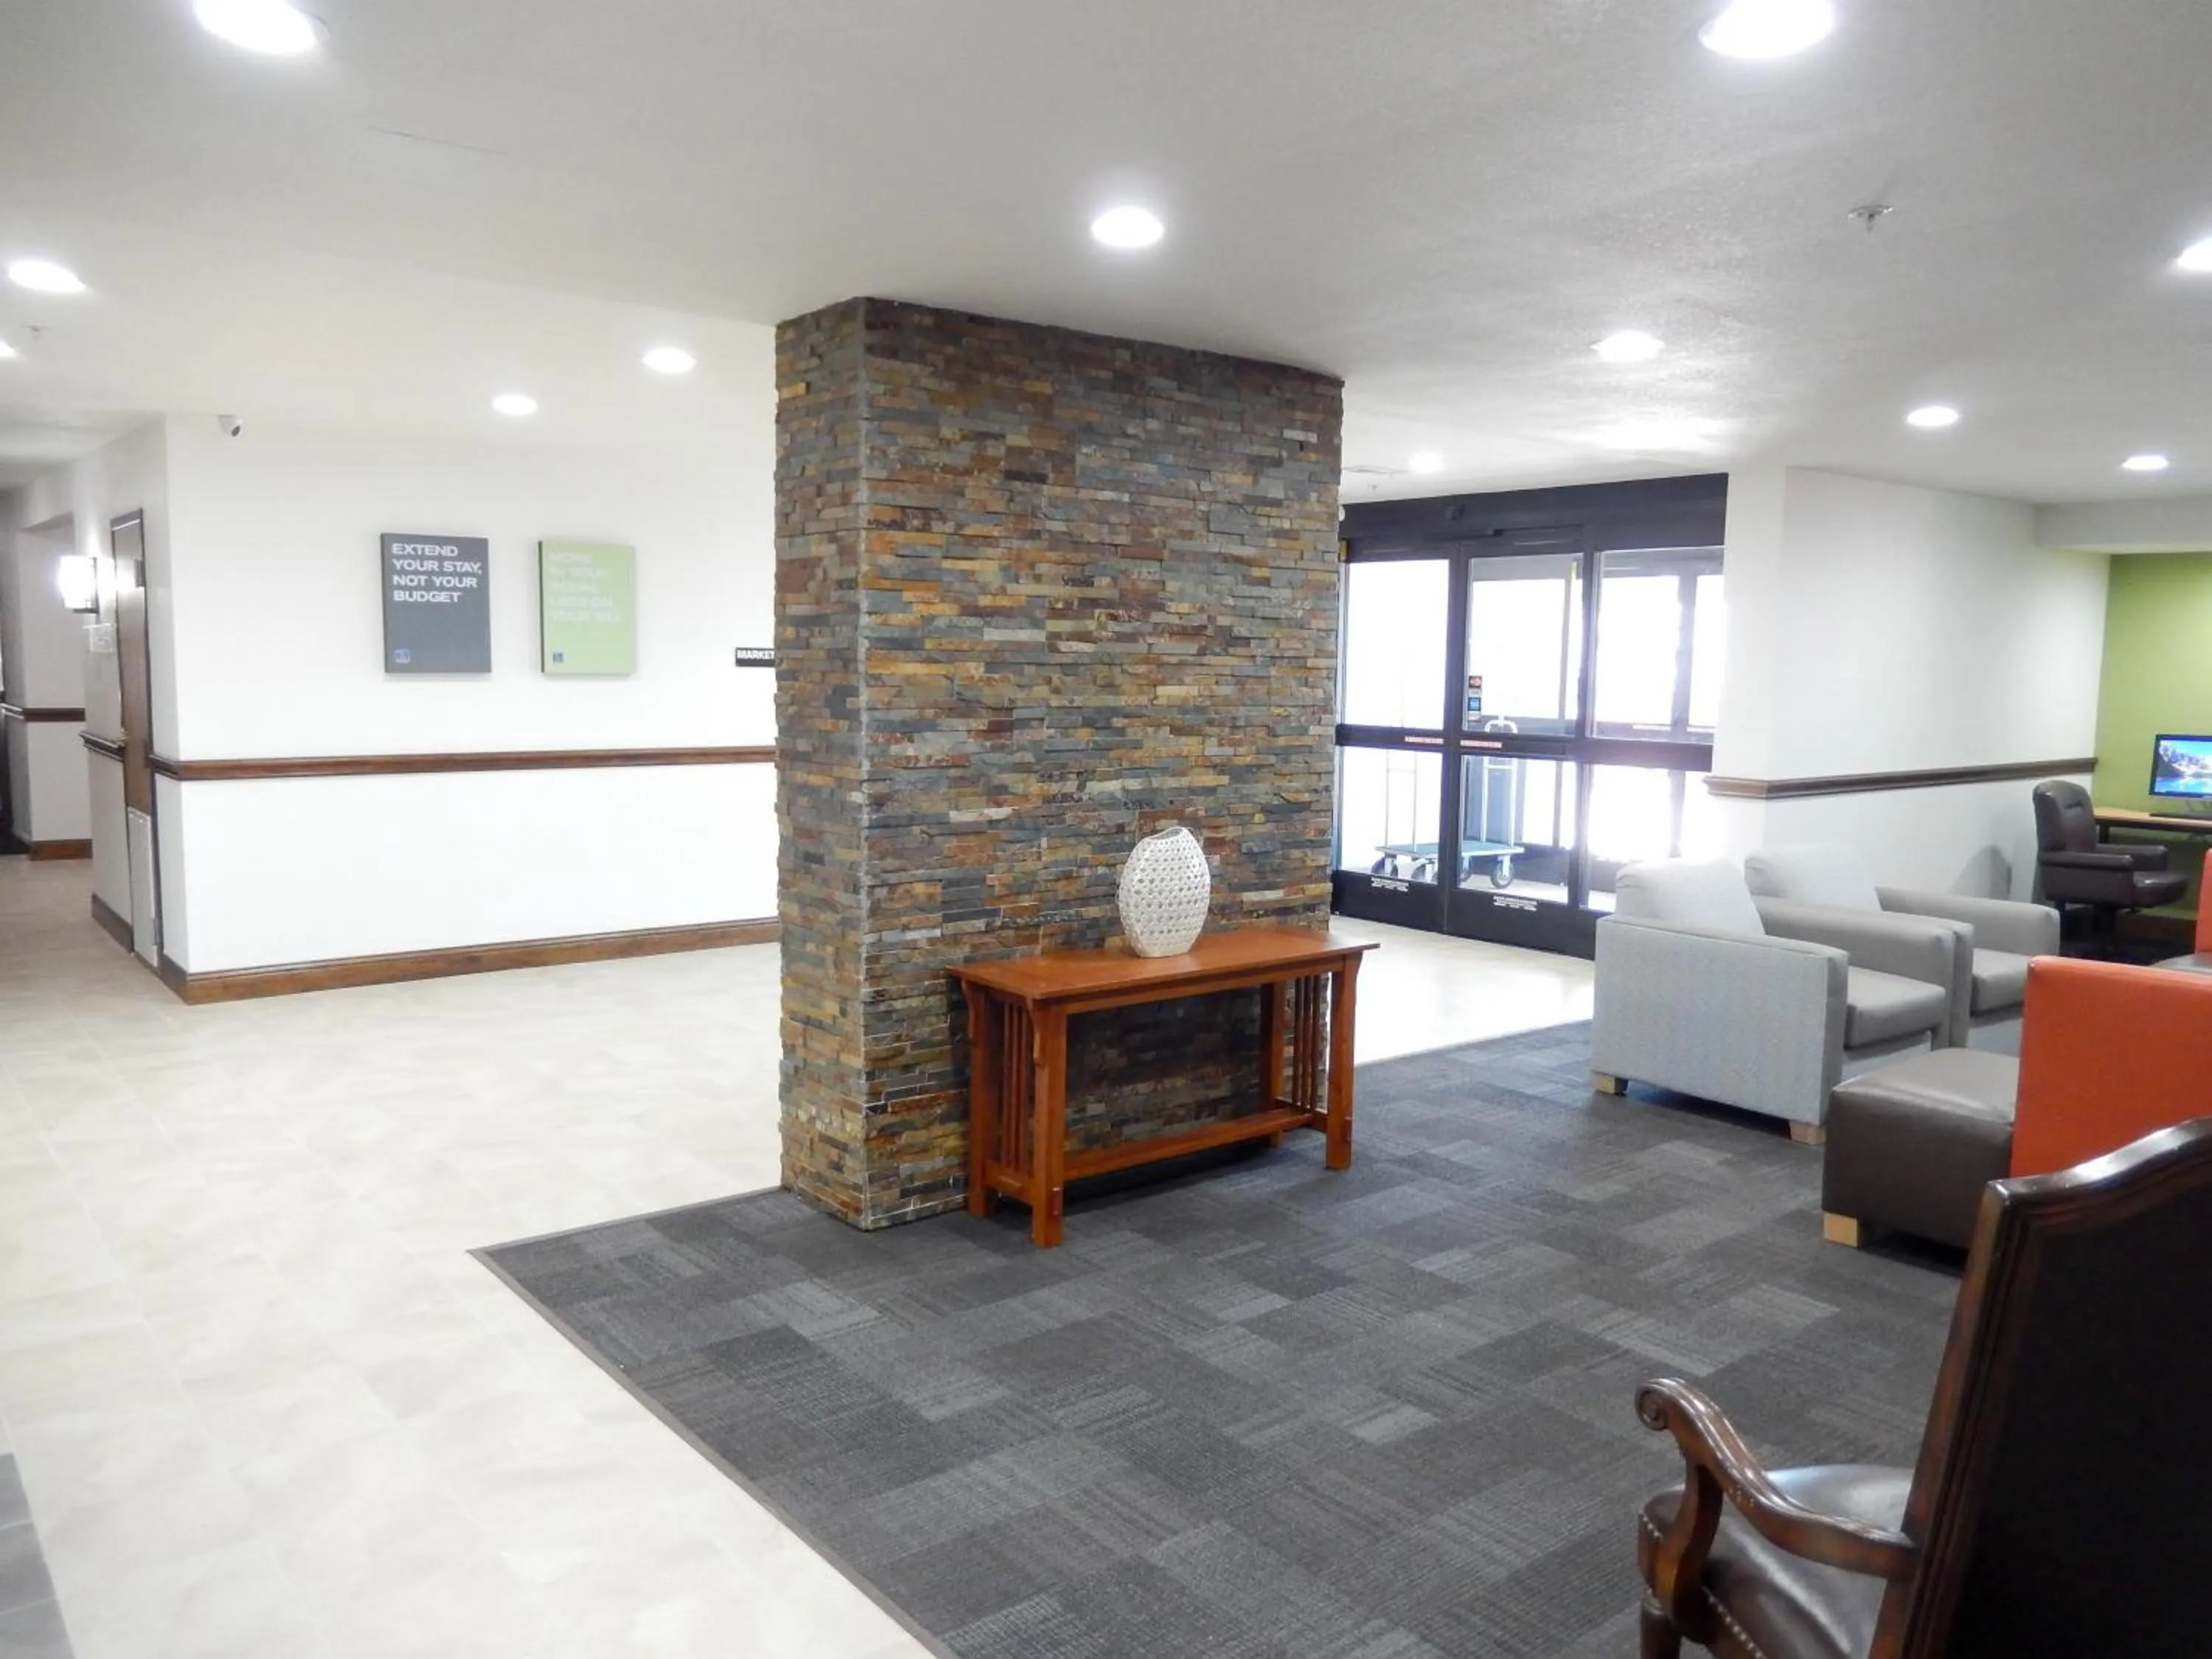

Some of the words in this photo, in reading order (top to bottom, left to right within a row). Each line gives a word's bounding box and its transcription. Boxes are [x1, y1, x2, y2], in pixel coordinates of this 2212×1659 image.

[392, 543, 459, 557] EXTEND
[392, 558, 439, 571] YOUR
[443, 561, 482, 575] STAY,
[392, 574, 428, 587] NOT
[431, 576, 479, 588] YOUR
[393, 589, 463, 603] BUDGET
